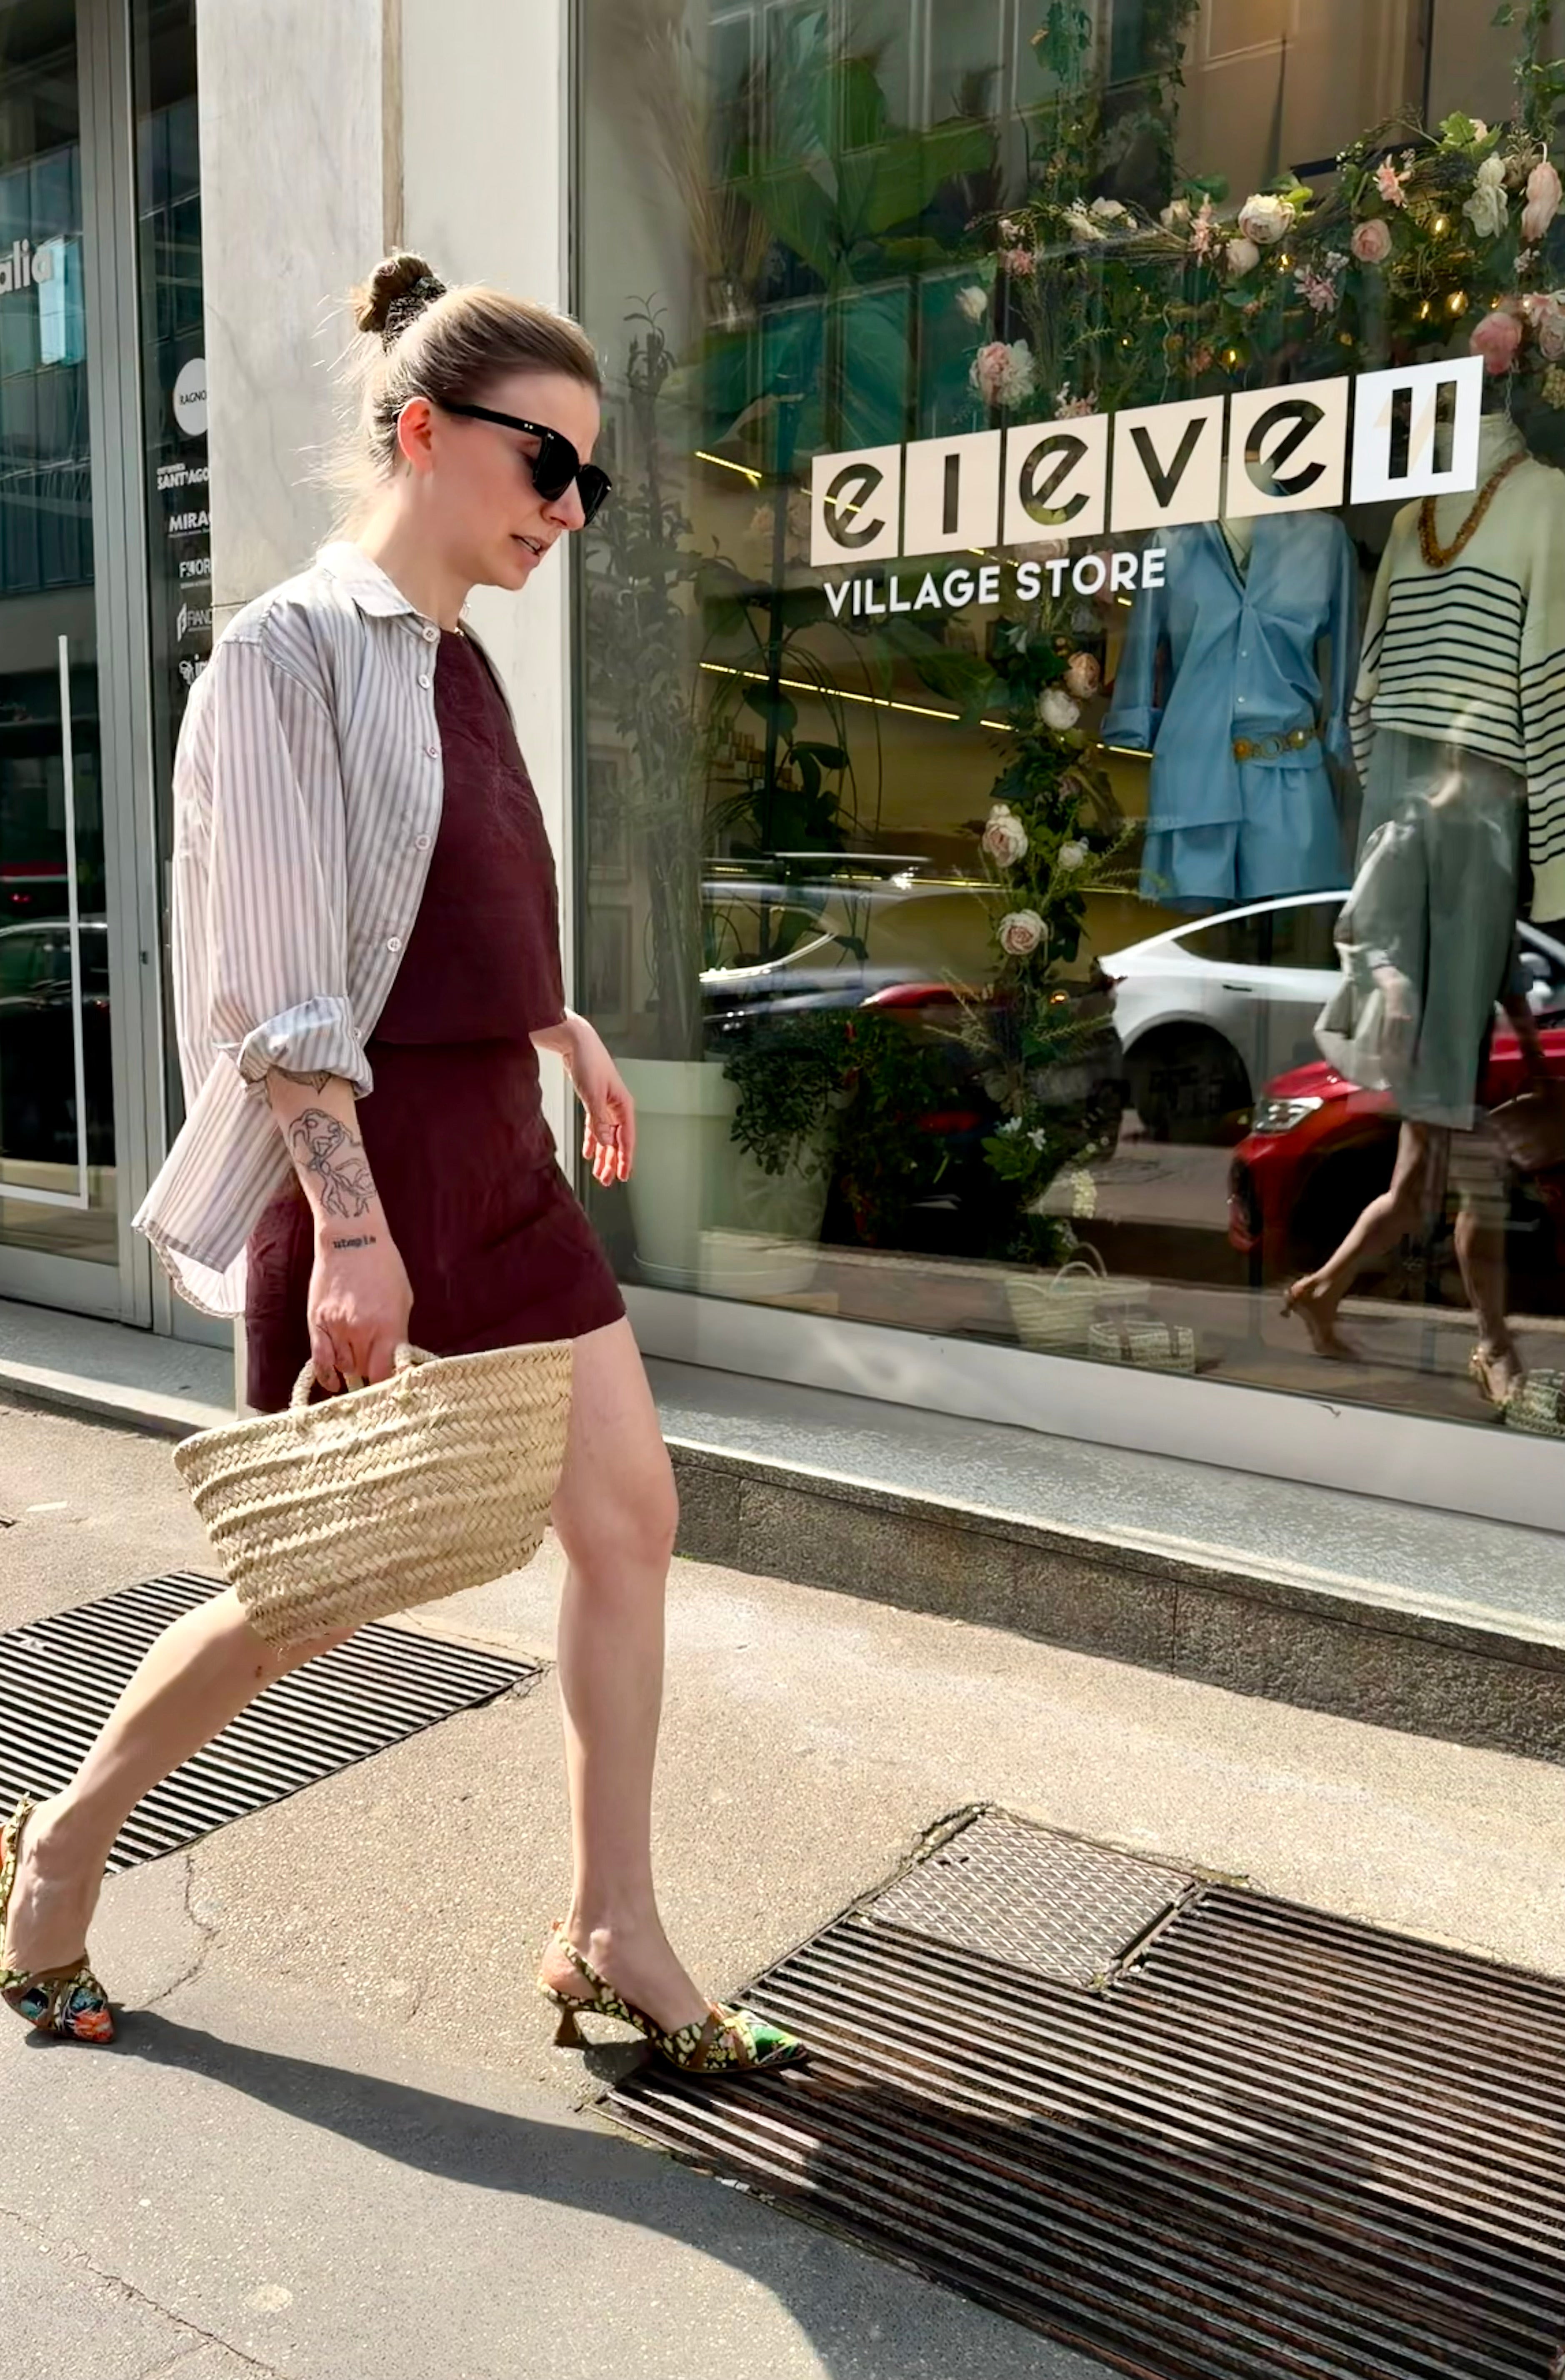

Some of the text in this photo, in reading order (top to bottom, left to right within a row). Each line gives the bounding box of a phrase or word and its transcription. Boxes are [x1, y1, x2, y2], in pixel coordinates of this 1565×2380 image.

[169, 511, 210, 532] MIRA
[823, 548, 1166, 617] VILLAGE STORE
